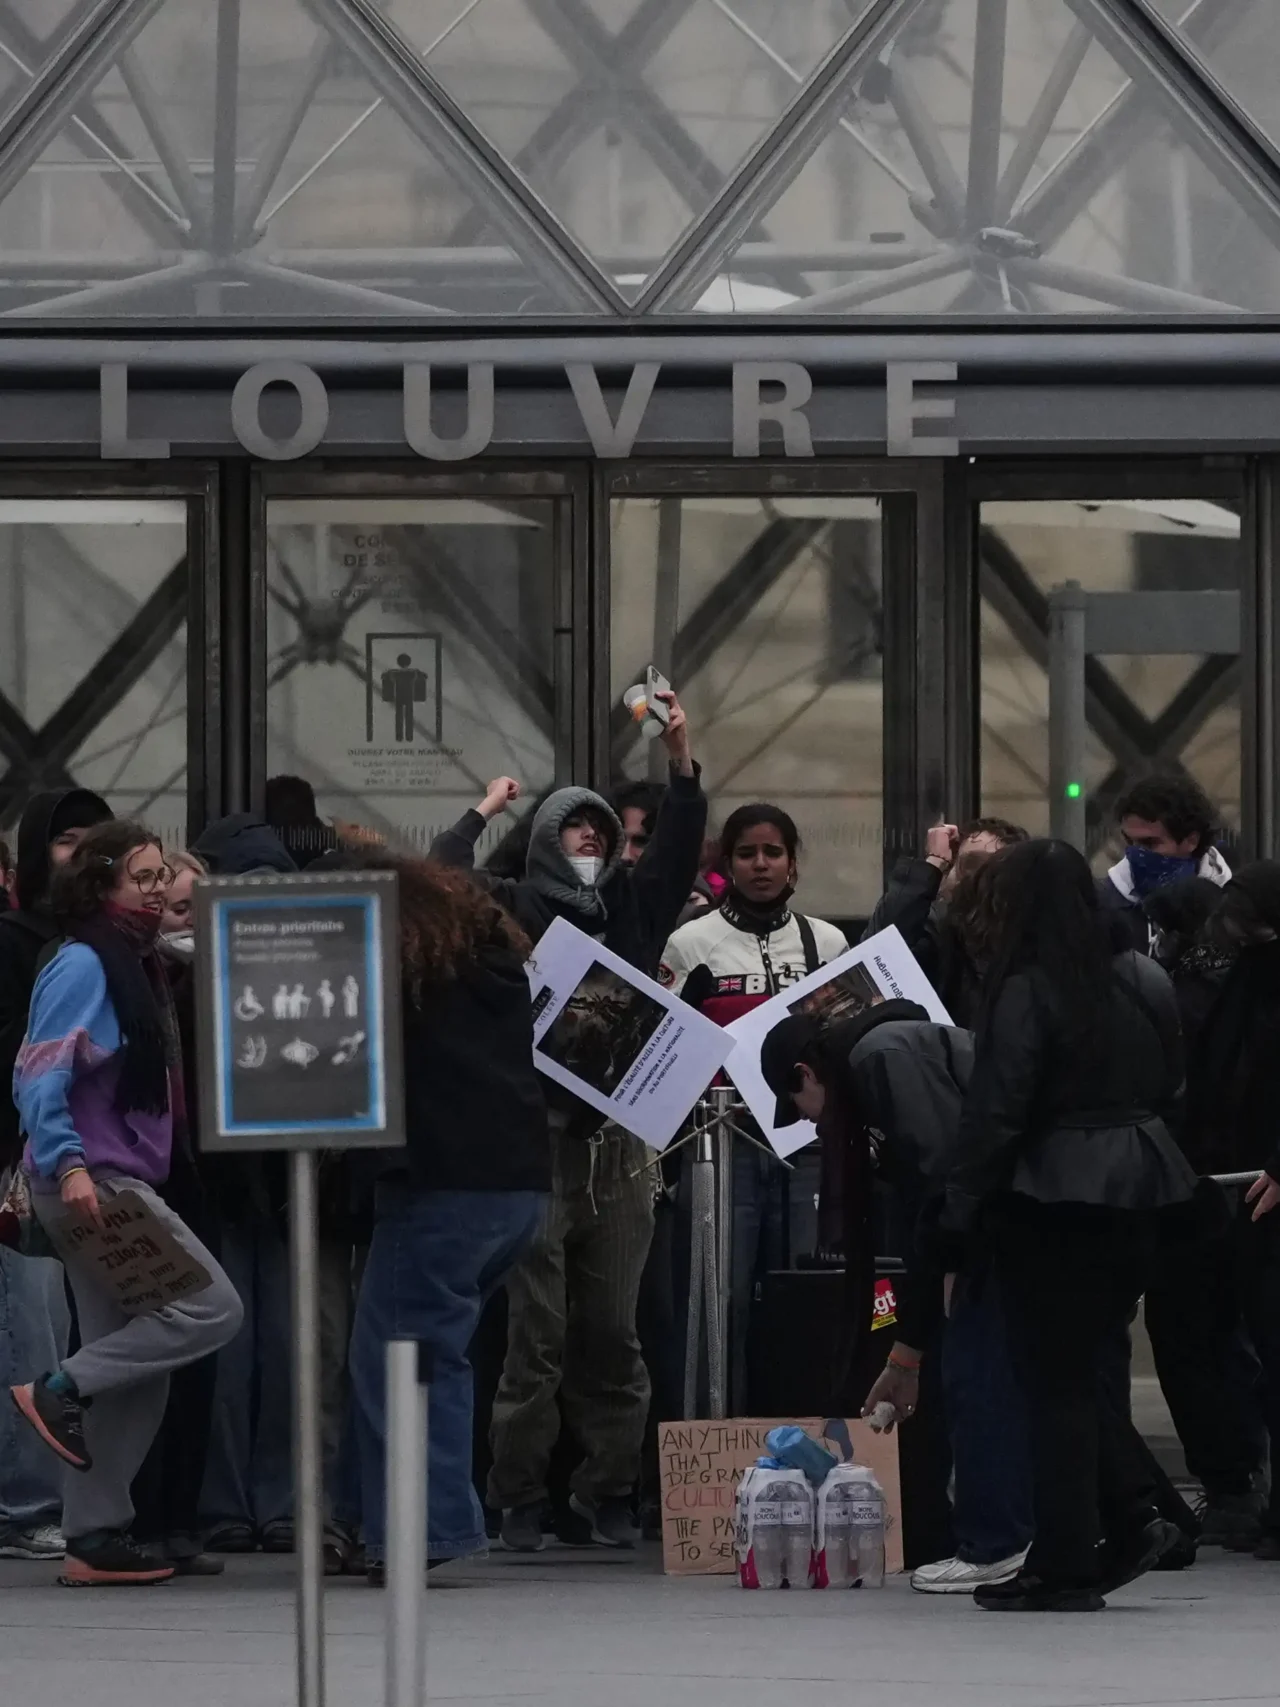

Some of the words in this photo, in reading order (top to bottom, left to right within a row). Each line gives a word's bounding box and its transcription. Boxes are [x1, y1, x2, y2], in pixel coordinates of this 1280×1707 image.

[100, 361, 959, 461] LOUVRE
[873, 1290, 897, 1315] gt
[662, 1427, 769, 1452] ANYTHIN
[665, 1452, 720, 1473] THAT
[665, 1486, 737, 1511] CULTU
[666, 1517, 701, 1538] THE
[713, 1517, 737, 1536] PA
[673, 1540, 701, 1561] TO
